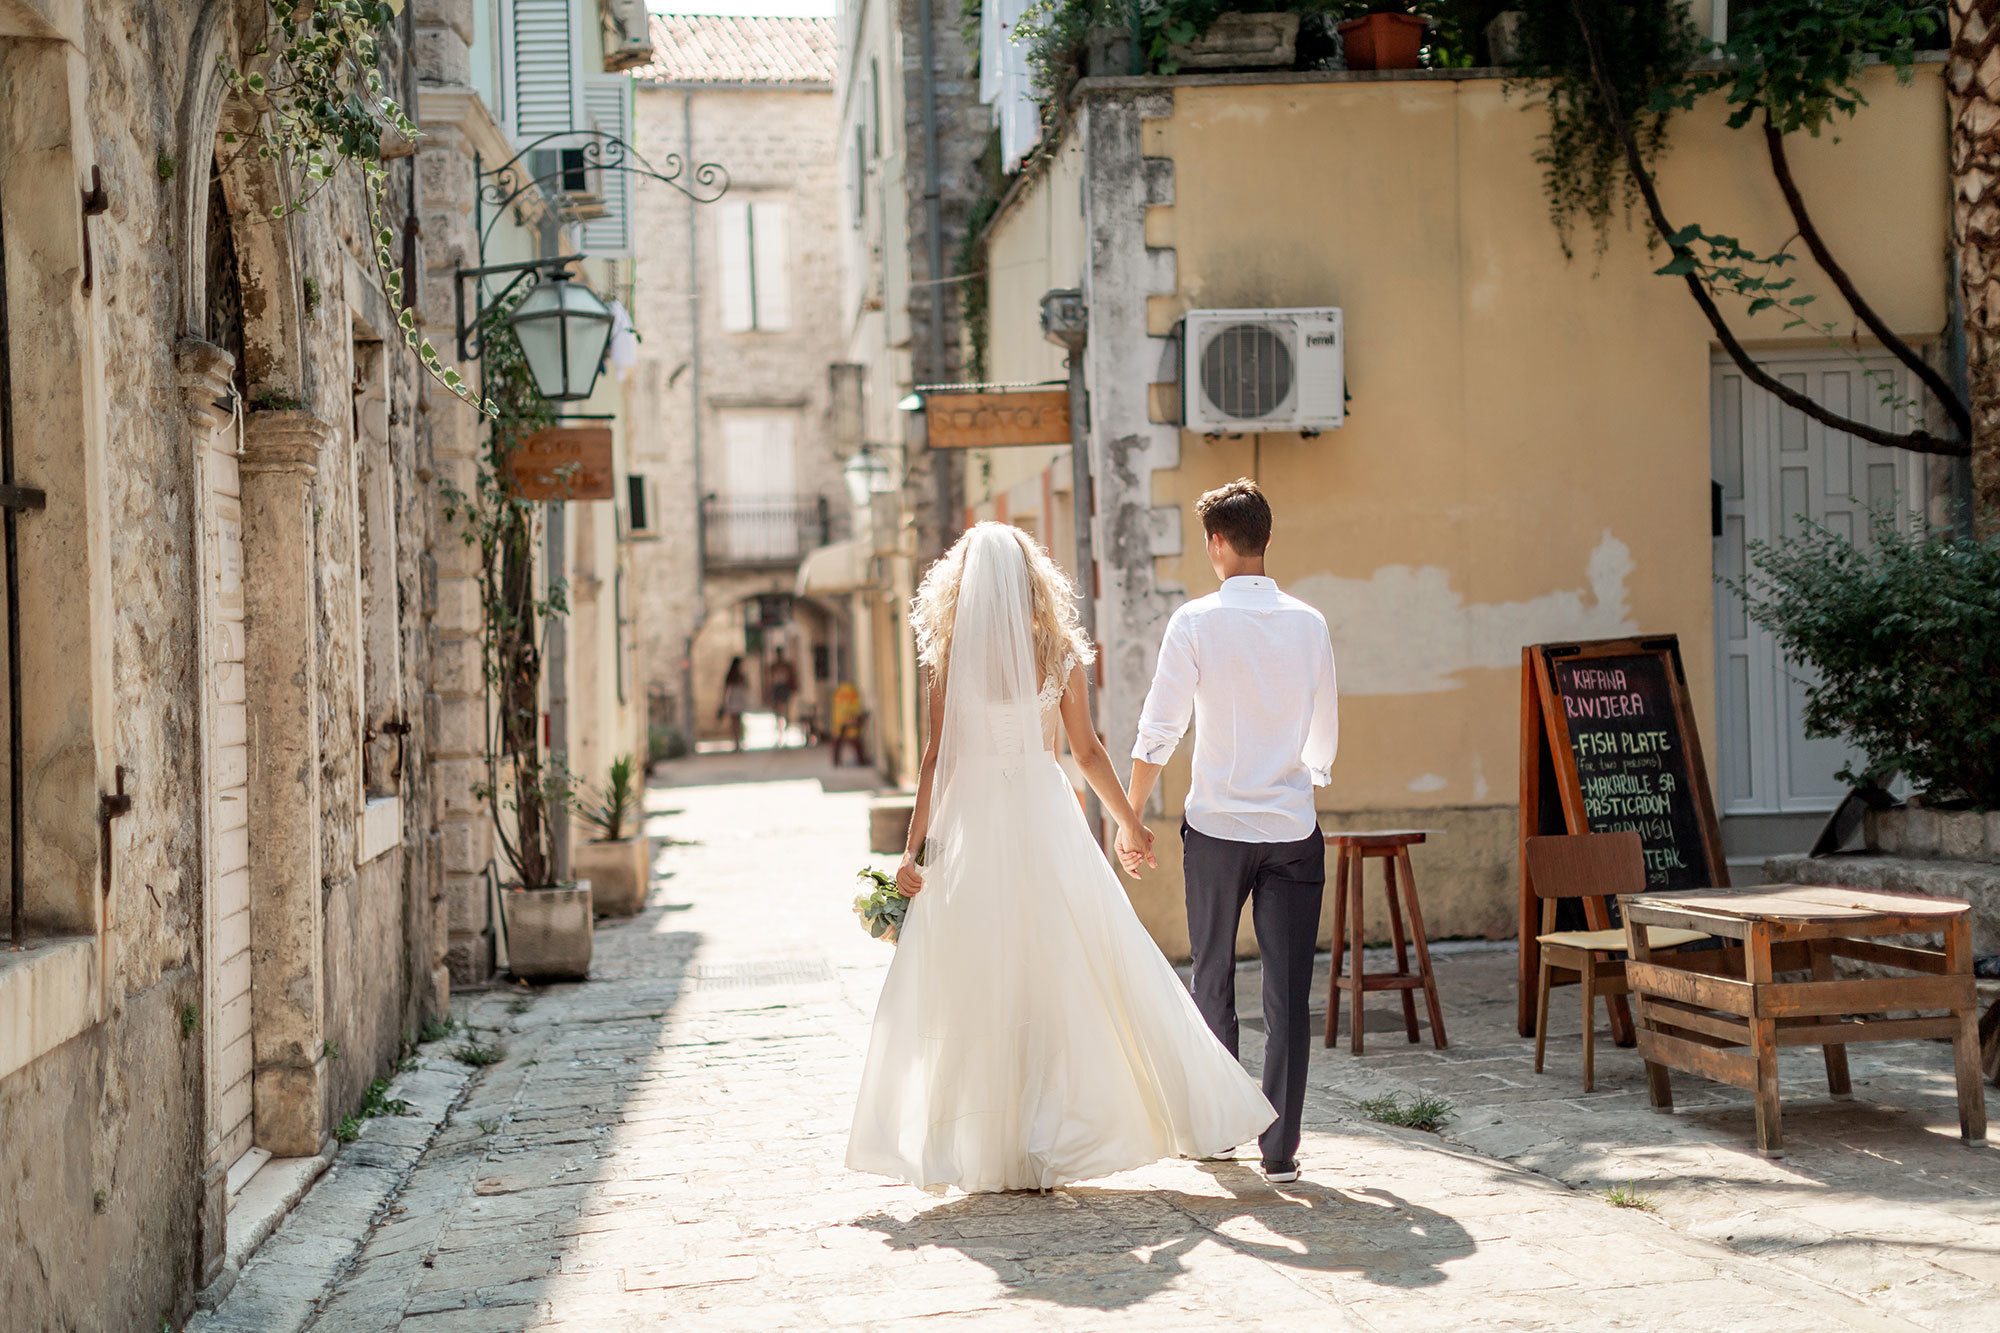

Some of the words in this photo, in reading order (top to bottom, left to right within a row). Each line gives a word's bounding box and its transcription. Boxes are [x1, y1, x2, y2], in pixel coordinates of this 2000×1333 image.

[1573, 669, 1627, 691] KAFANA
[1563, 693, 1645, 719] RIVIJERA
[1621, 731, 1671, 754] PLATE
[1658, 772, 1676, 792] SA
[1643, 847, 1688, 870] TEAK
[1655, 970, 1702, 1003] PRIVATE
